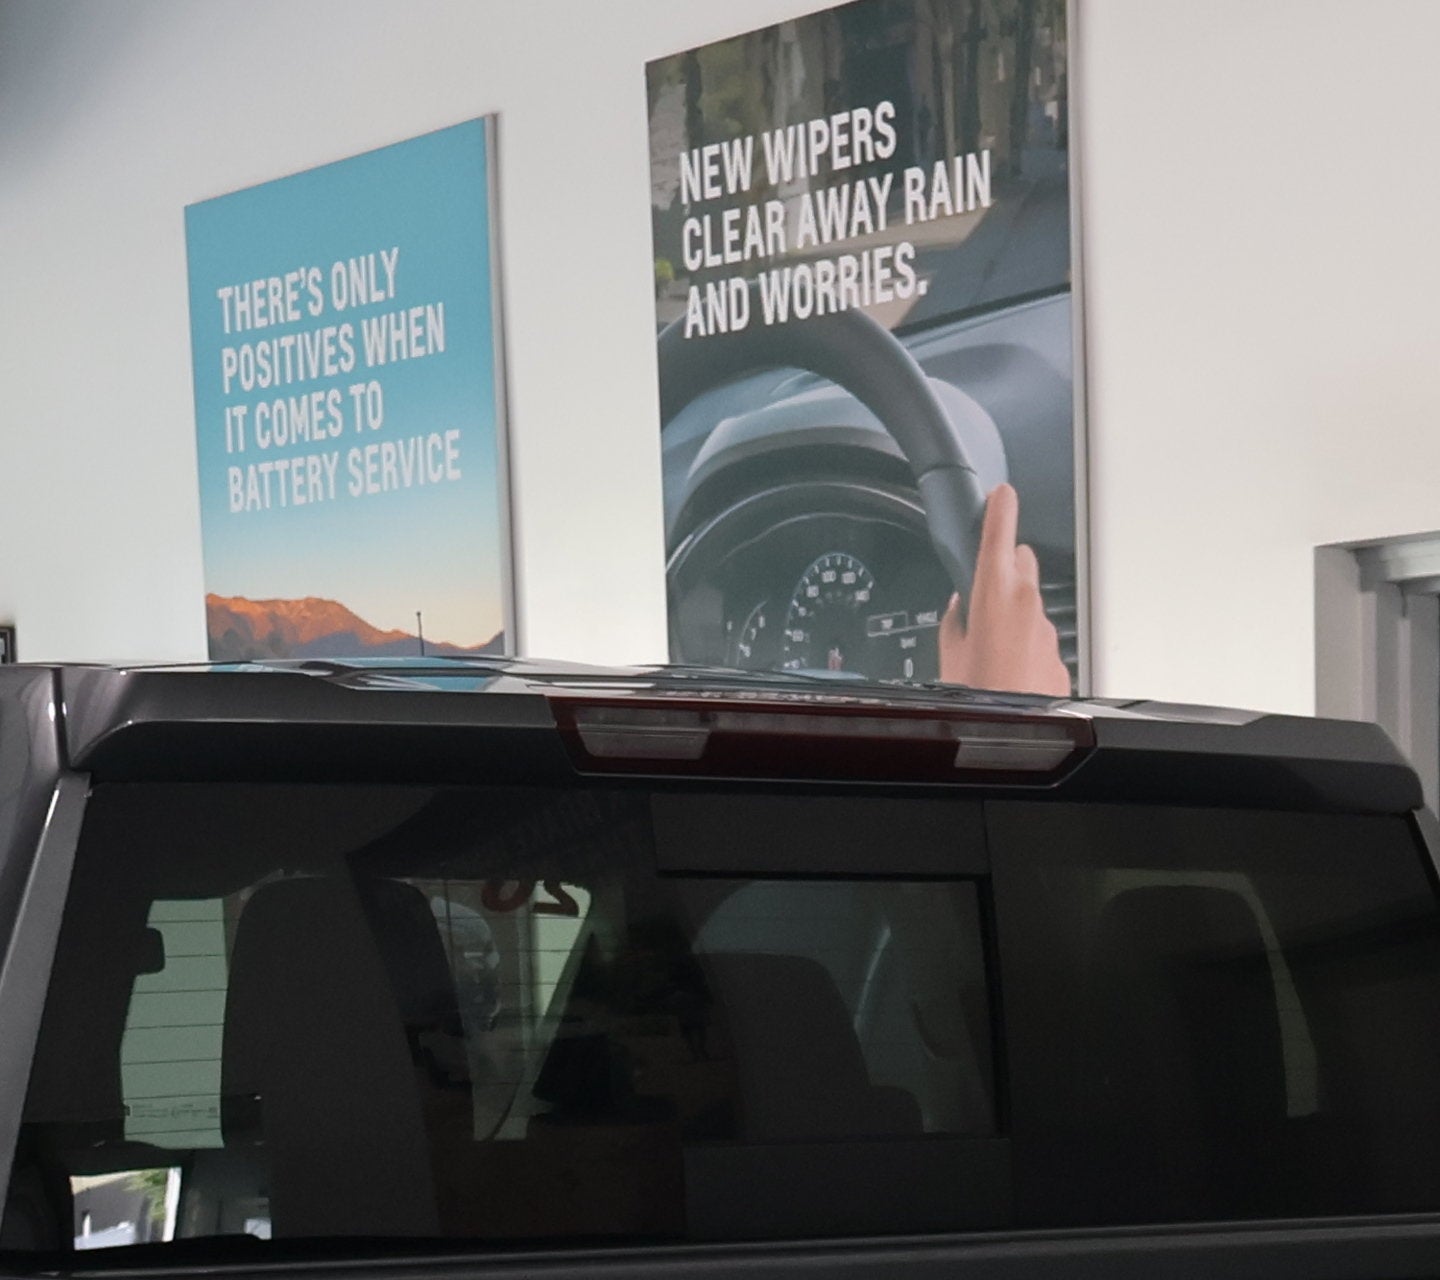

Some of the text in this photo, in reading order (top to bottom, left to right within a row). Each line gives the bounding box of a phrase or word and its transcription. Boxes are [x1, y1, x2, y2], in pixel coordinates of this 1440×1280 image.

[679, 100, 897, 205] NEW WIPERS
[682, 149, 992, 272] CLEAR AWAY RAIN
[216, 246, 400, 335] THERE'S ONLY
[684, 241, 927, 339] AND WORRIES.
[221, 301, 446, 394] POSITIVES WHEN
[224, 380, 384, 453] IT COMES TO
[227, 428, 461, 514] BATTERY SERVICE
